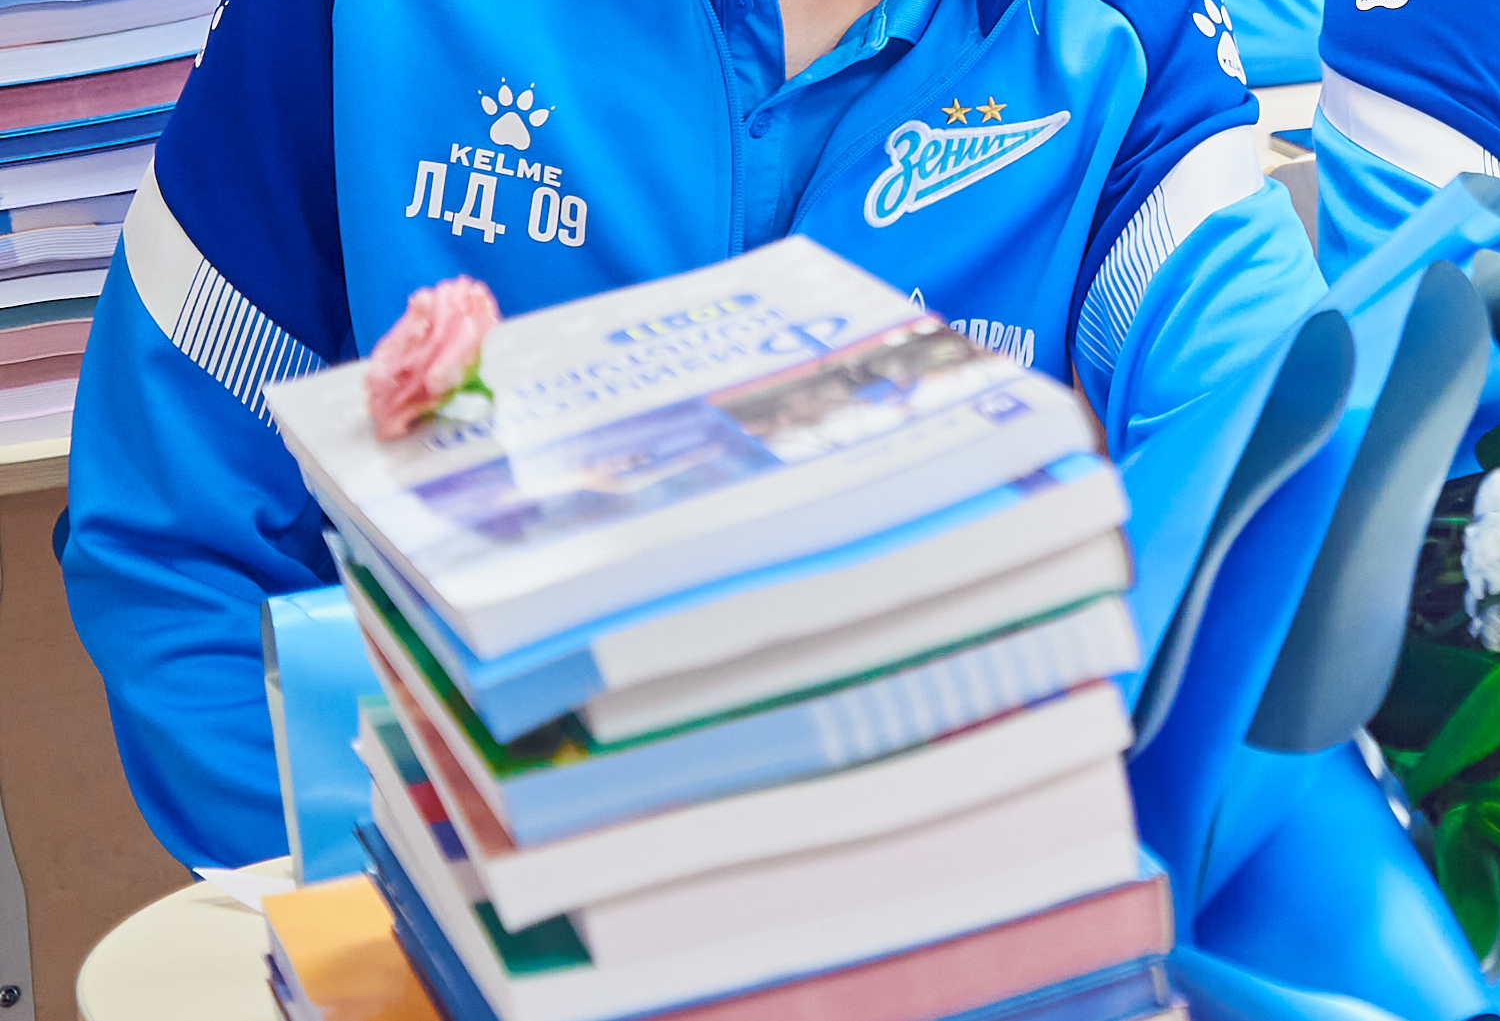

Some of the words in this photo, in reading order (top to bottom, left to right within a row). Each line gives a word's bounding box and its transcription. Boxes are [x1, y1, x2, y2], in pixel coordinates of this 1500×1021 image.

[449, 142, 563, 188] KELME
[873, 120, 1057, 220] Зенит
[527, 185, 588, 248] 09
